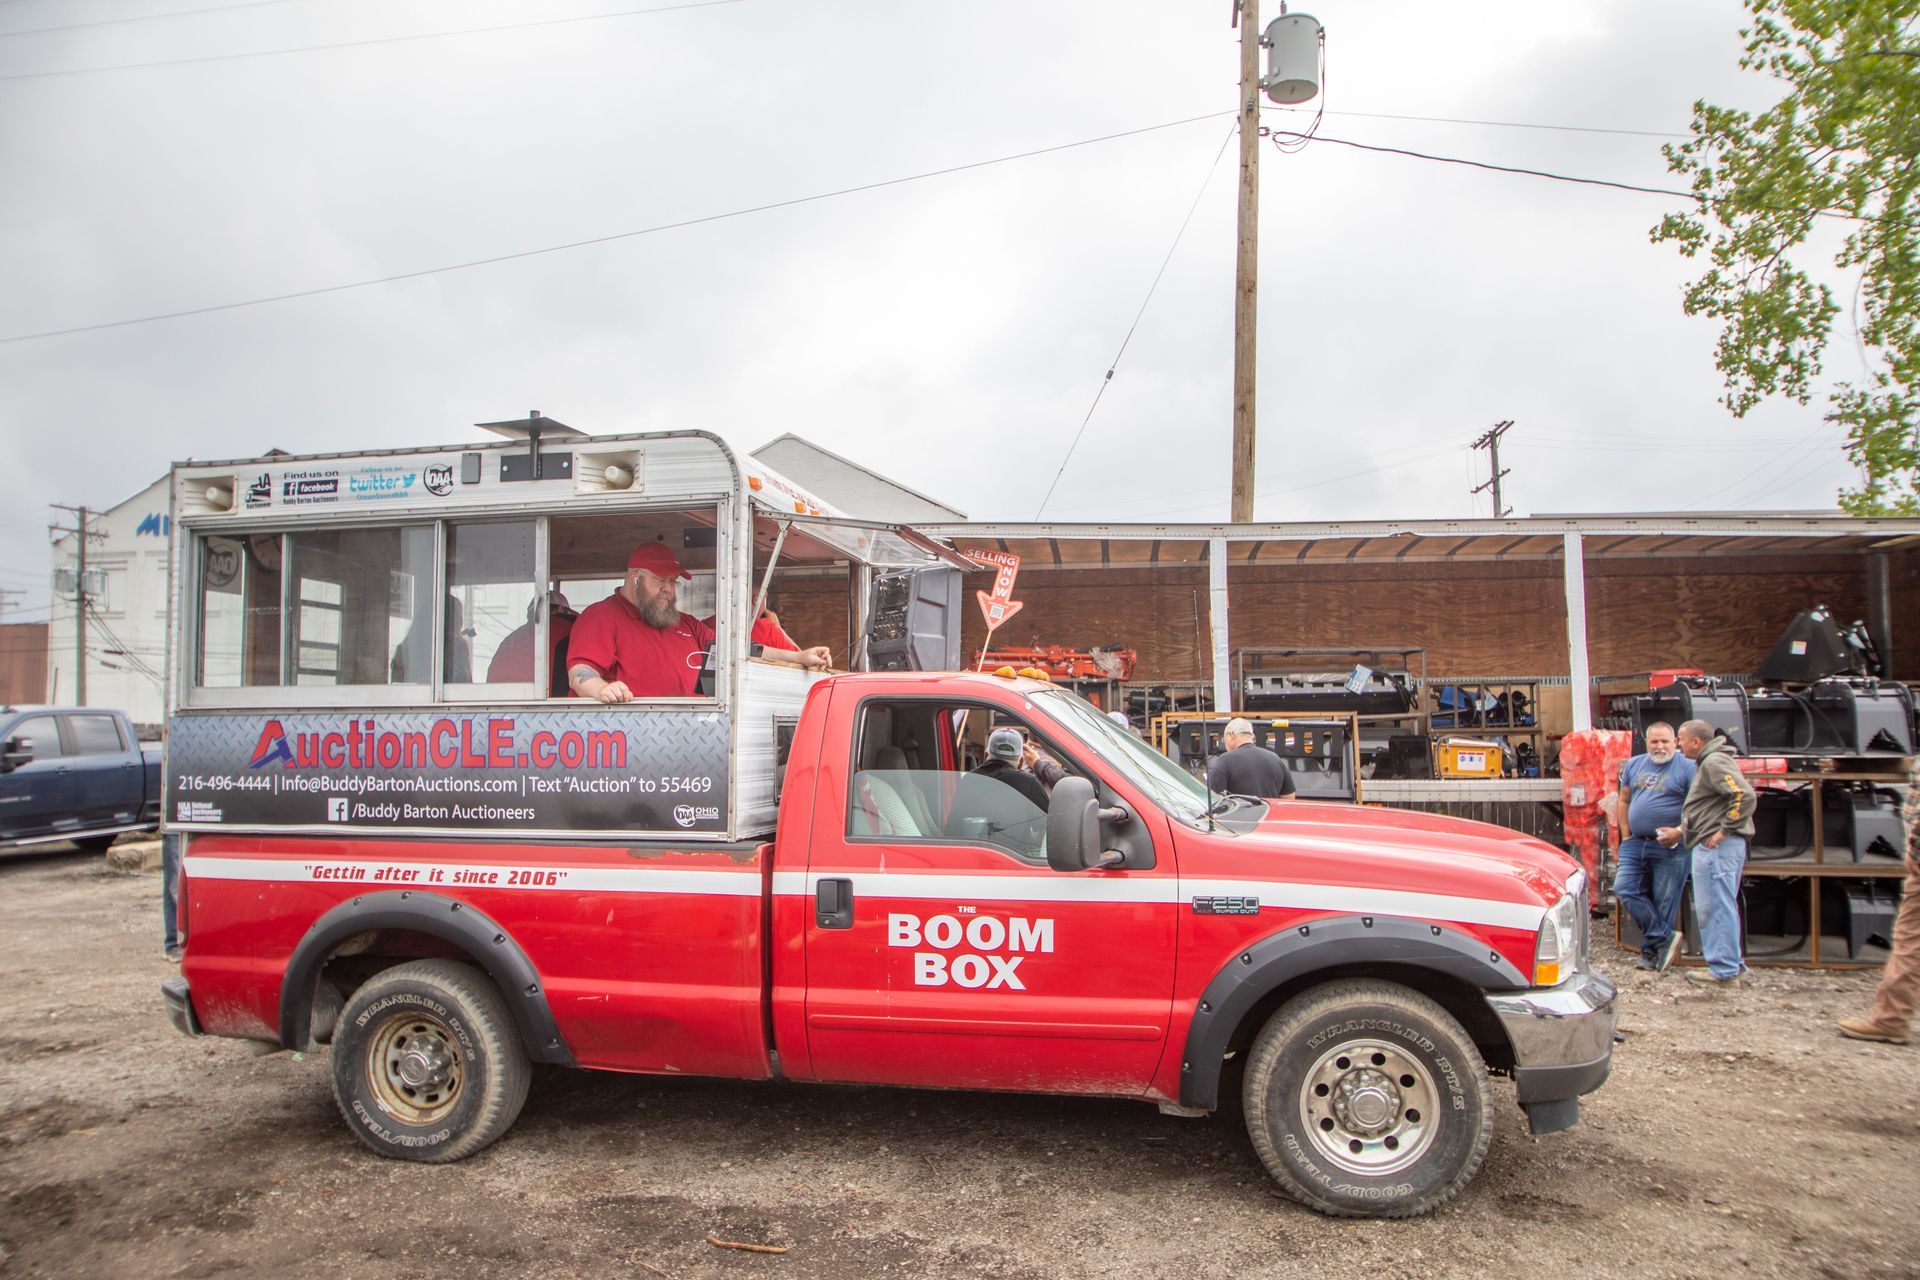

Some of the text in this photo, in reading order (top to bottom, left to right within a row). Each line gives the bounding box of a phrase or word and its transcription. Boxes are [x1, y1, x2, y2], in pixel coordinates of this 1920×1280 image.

[300, 482, 335, 493] facebook
[349, 474, 400, 492] twitter
[966, 548, 1016, 566] SELLING
[996, 566, 1013, 597] NOW
[249, 718, 628, 769] AuctionCLE.com
[178, 775, 271, 791] 216-496-4444
[281, 776, 518, 795] Info@BuddyBartonAuctions.com
[528, 776, 562, 792] Text
[638, 778, 656, 792] to
[660, 776, 712, 793] 55469
[352, 804, 401, 822] /Buddy
[403, 804, 448, 819] Barton
[451, 804, 535, 820] Auctioneers
[374, 866, 420, 881] after
[428, 867, 444, 882] it
[453, 869, 498, 884] since
[957, 905, 977, 914] THE
[888, 913, 1054, 953] BOOM
[914, 952, 1027, 990] BOX
[356, 994, 446, 1027] WRANGLER
[1307, 1019, 1434, 1052] WRANGLER
[352, 1100, 450, 1147] GOODYEAR
[1284, 1134, 1413, 1199] GOODYEAR
